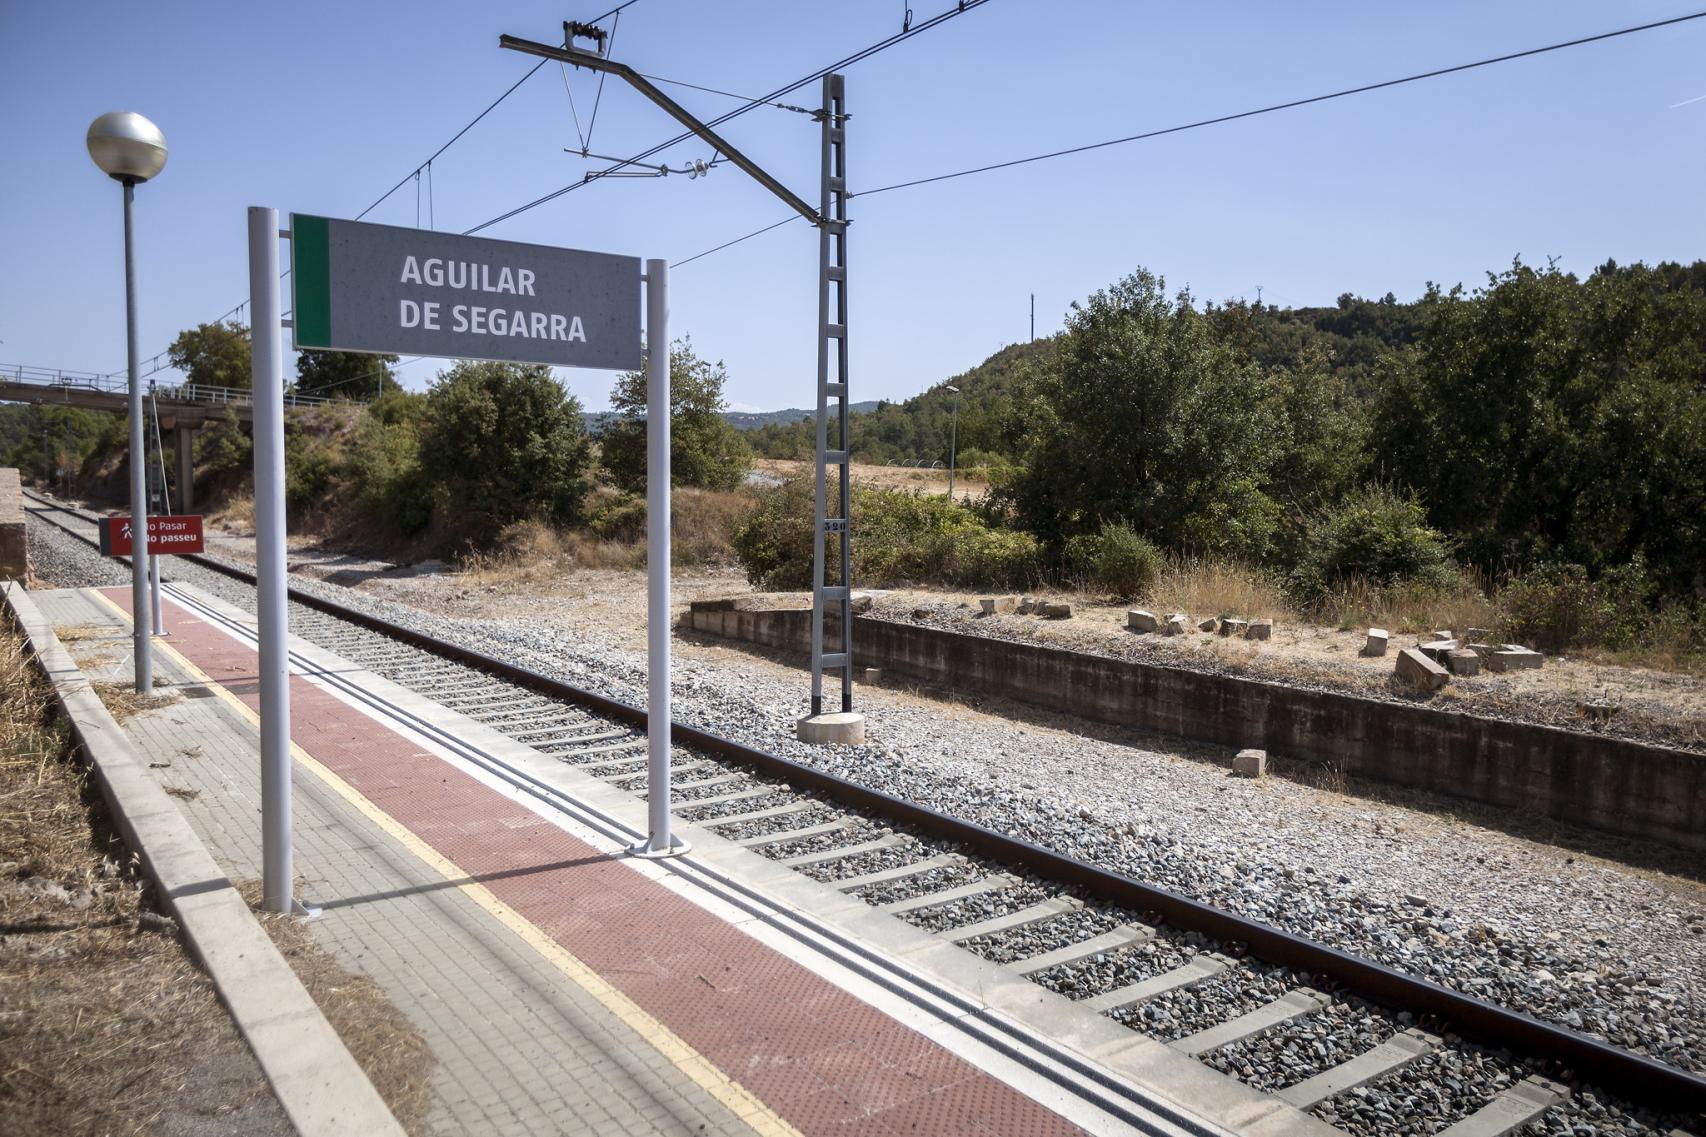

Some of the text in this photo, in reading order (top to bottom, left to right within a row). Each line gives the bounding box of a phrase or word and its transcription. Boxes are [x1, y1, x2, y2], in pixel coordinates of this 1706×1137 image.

[400, 255, 536, 297] AGUILAR
[400, 299, 587, 343] DE SEGARRA
[160, 521, 187, 530] Pasar
[161, 534, 197, 544] passeu
